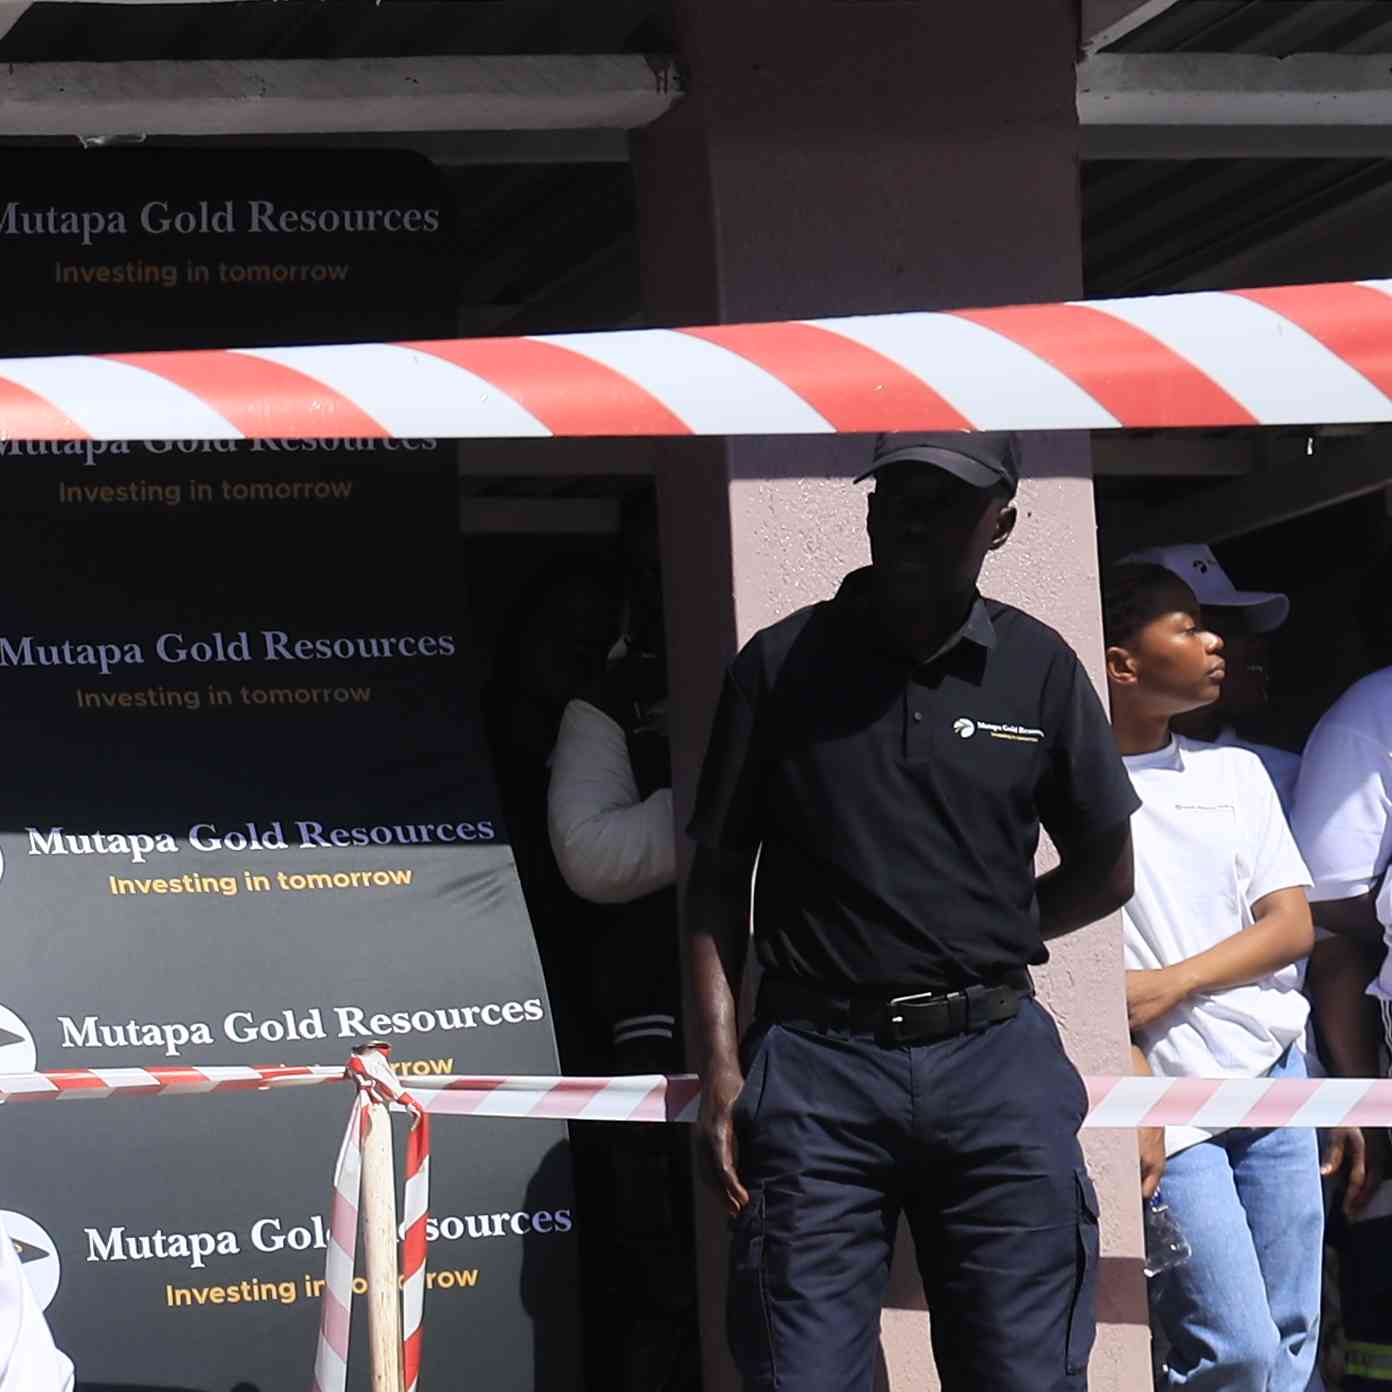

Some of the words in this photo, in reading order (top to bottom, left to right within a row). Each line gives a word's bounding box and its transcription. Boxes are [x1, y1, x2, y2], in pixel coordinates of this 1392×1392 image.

[141, 201, 235, 234] Gold
[248, 201, 438, 232] Resources
[56, 261, 177, 287] Investing
[187, 261, 209, 283] in
[219, 263, 348, 282] tomorrow
[60, 480, 180, 505] Investing
[190, 480, 212, 500] in
[222, 480, 352, 500] tomorrow
[157, 632, 251, 663] Gold
[263, 631, 454, 660] Resources
[77, 687, 200, 709] Investing
[209, 685, 232, 704] in
[240, 683, 370, 704] tomorrow
[27, 824, 178, 863] Mutapa
[187, 824, 288, 852] Gold
[296, 816, 496, 849] Resources
[110, 873, 239, 895] Investing
[245, 872, 270, 891] in
[278, 870, 413, 889] tomorrow
[58, 1017, 213, 1056] Mutapa
[224, 1009, 326, 1043] Gold
[334, 999, 545, 1039] Resources
[390, 1057, 453, 1076] rrow
[84, 1227, 239, 1268] Mutapa
[252, 1216, 329, 1252] Gol
[399, 1208, 572, 1240] sources
[167, 1278, 295, 1306] Investing
